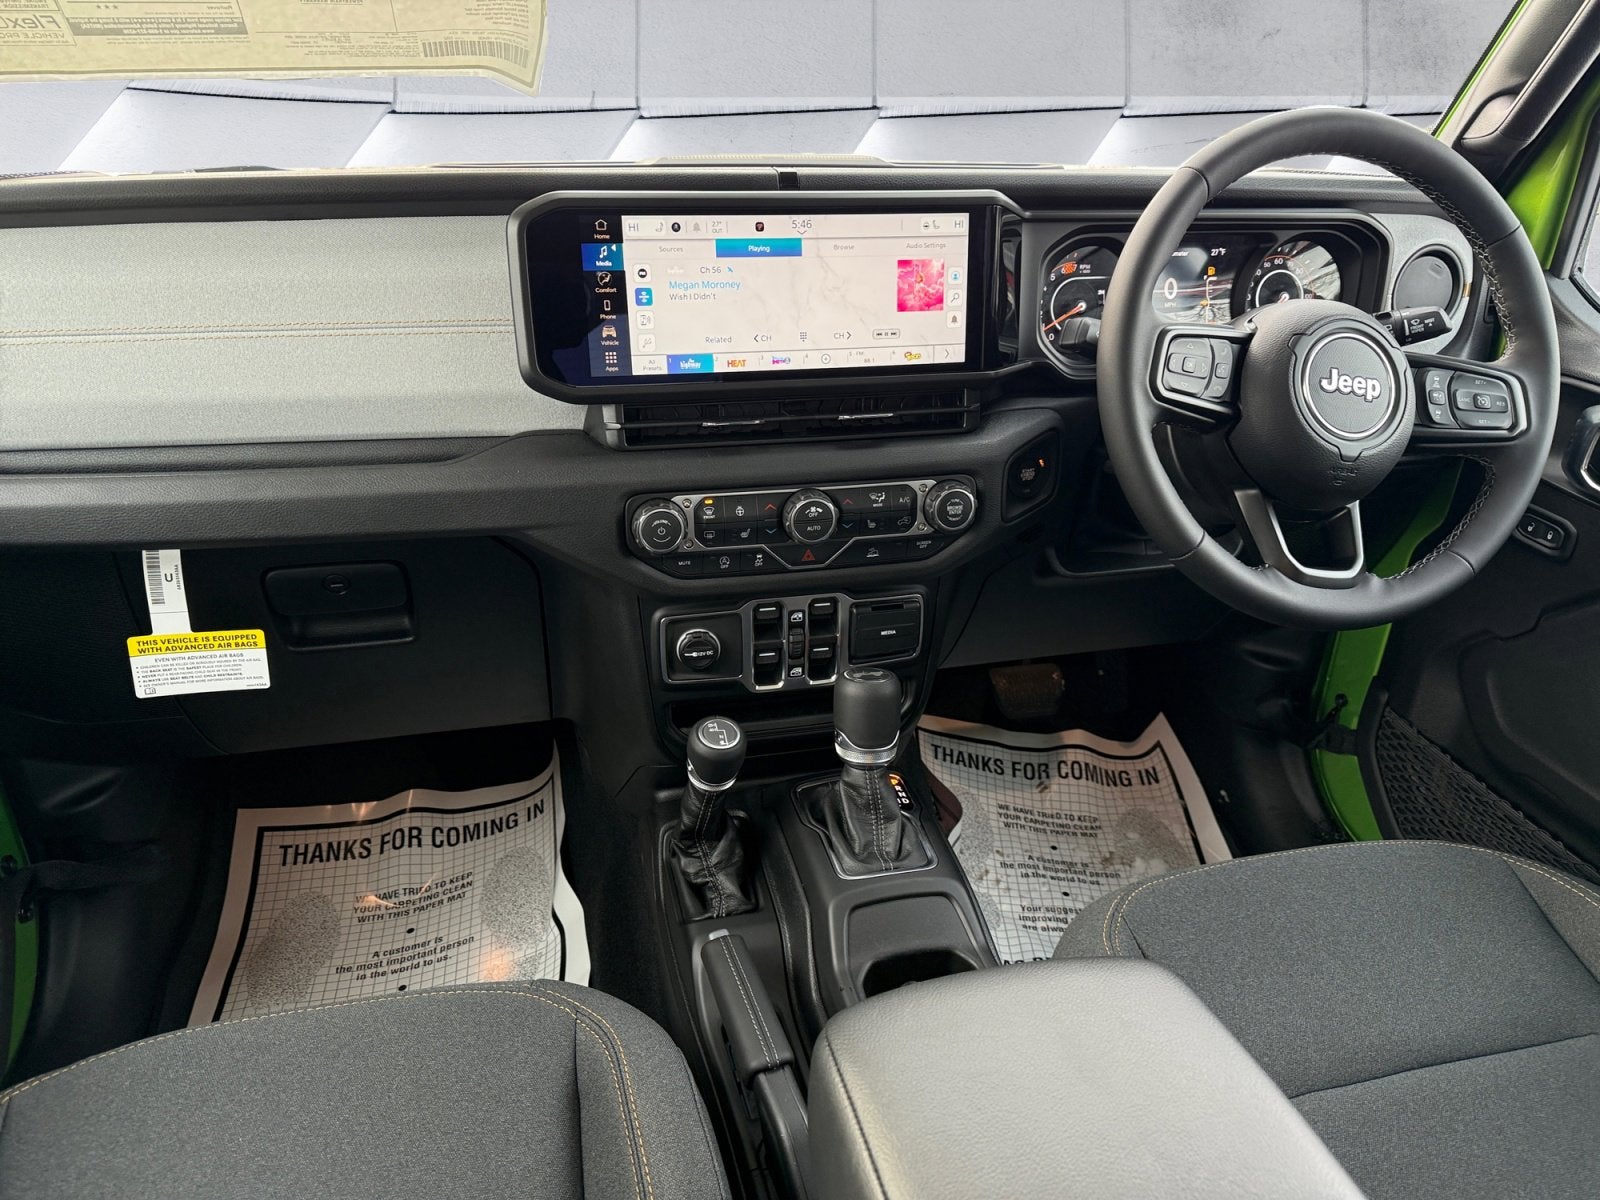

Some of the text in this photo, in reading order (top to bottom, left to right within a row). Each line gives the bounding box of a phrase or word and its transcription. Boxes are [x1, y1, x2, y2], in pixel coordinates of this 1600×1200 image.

[791, 219, 813, 229] 5:46
[748, 245, 771, 253] Playing
[924, 241, 947, 250] Settings
[668, 280, 741, 291] Megan Moroney
[1164, 277, 1178, 300] 0
[669, 293, 688, 301] Wish
[693, 292, 717, 301] Didn't
[705, 336, 732, 344] Related
[727, 359, 747, 368] HEAT
[1320, 366, 1382, 402] Jeep
[160, 636, 199, 645] VEHICLE
[212, 633, 257, 642] EQUIPPED
[137, 646, 162, 655] WITH
[165, 643, 215, 653] ADVANCED
[234, 640, 258, 648] BAGS
[930, 743, 1160, 787] THANKS FOR COMING IN
[997, 803, 1011, 812] WE
[1012, 806, 1034, 816] HAVE
[1063, 813, 1075, 822] TO
[1077, 815, 1099, 825] KEEP
[998, 812, 1102, 832] YOUR CARPETING CLEAN
[279, 798, 545, 867] THANKS FOR COMING IN
[1002, 821, 1099, 839] WITH THIS PAPER MAT
[999, 861, 1121, 879] the most important person
[1036, 856, 1078, 868] customer
[1080, 861, 1090, 869] is
[1020, 870, 1030, 878] in
[1031, 871, 1048, 880] the
[1049, 874, 1076, 883] world
[1078, 877, 1087, 885] to
[375, 889, 400, 901] HAVE
[434, 880, 447, 890] TO
[449, 871, 473, 885] KEEP
[353, 904, 382, 914] YOUR
[442, 880, 473, 896] CLEAN
[357, 891, 467, 923] WITH THIS PAPER MAT
[1020, 904, 1042, 913] Your
[1018, 914, 1068, 925] improving
[1022, 924, 1038, 932] are
[335, 936, 475, 975] the most important person
[371, 936, 444, 959] A customer is
[356, 972, 367, 981] in
[370, 969, 388, 979] the
[390, 961, 421, 976] world
[423, 958, 434, 967] to
